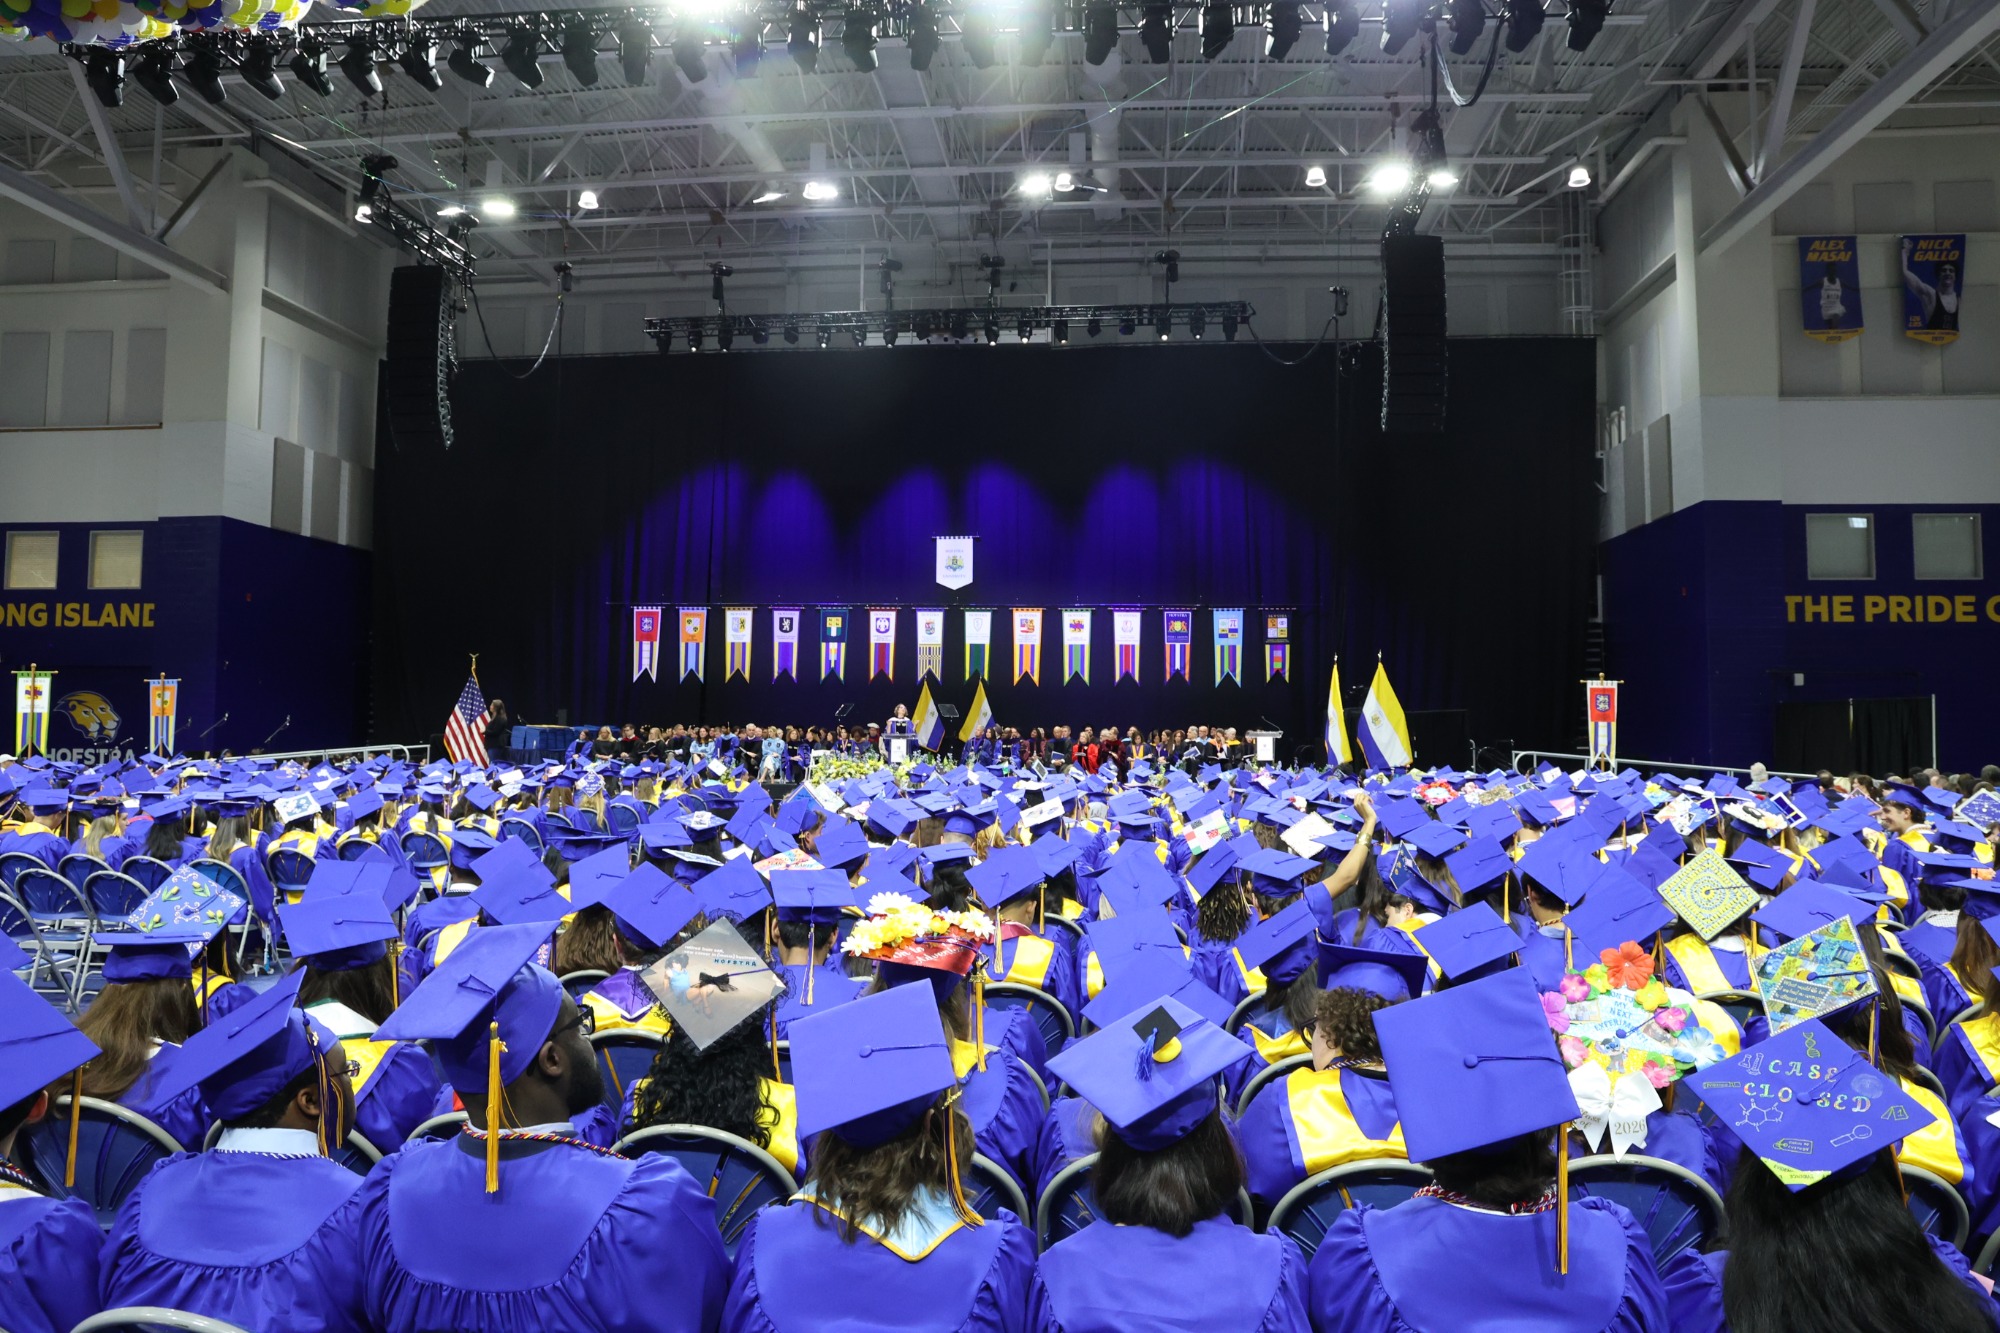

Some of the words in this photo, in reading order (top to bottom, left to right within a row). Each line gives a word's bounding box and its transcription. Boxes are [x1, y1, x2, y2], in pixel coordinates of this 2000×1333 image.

[1809, 239, 1847, 250] ALEX
[1917, 238, 1954, 250] NICK
[1806, 251, 1853, 262] MASAI
[1913, 250, 1960, 261] GALLO
[0, 602, 48, 627] NG
[1785, 595, 1855, 622] THE
[1864, 595, 1977, 622] PRIDE
[714, 958, 757, 966] HOFSTRA
[1611, 991, 1621, 999] ON
[1624, 994, 1634, 1002] TO
[1615, 1001, 1626, 1009] MY
[1610, 1007, 1632, 1019] NEXT
[1768, 1059, 1839, 1083] CASE
[1743, 1082, 1872, 1112] CLOSED
[1614, 1119, 1646, 1135] 2026
